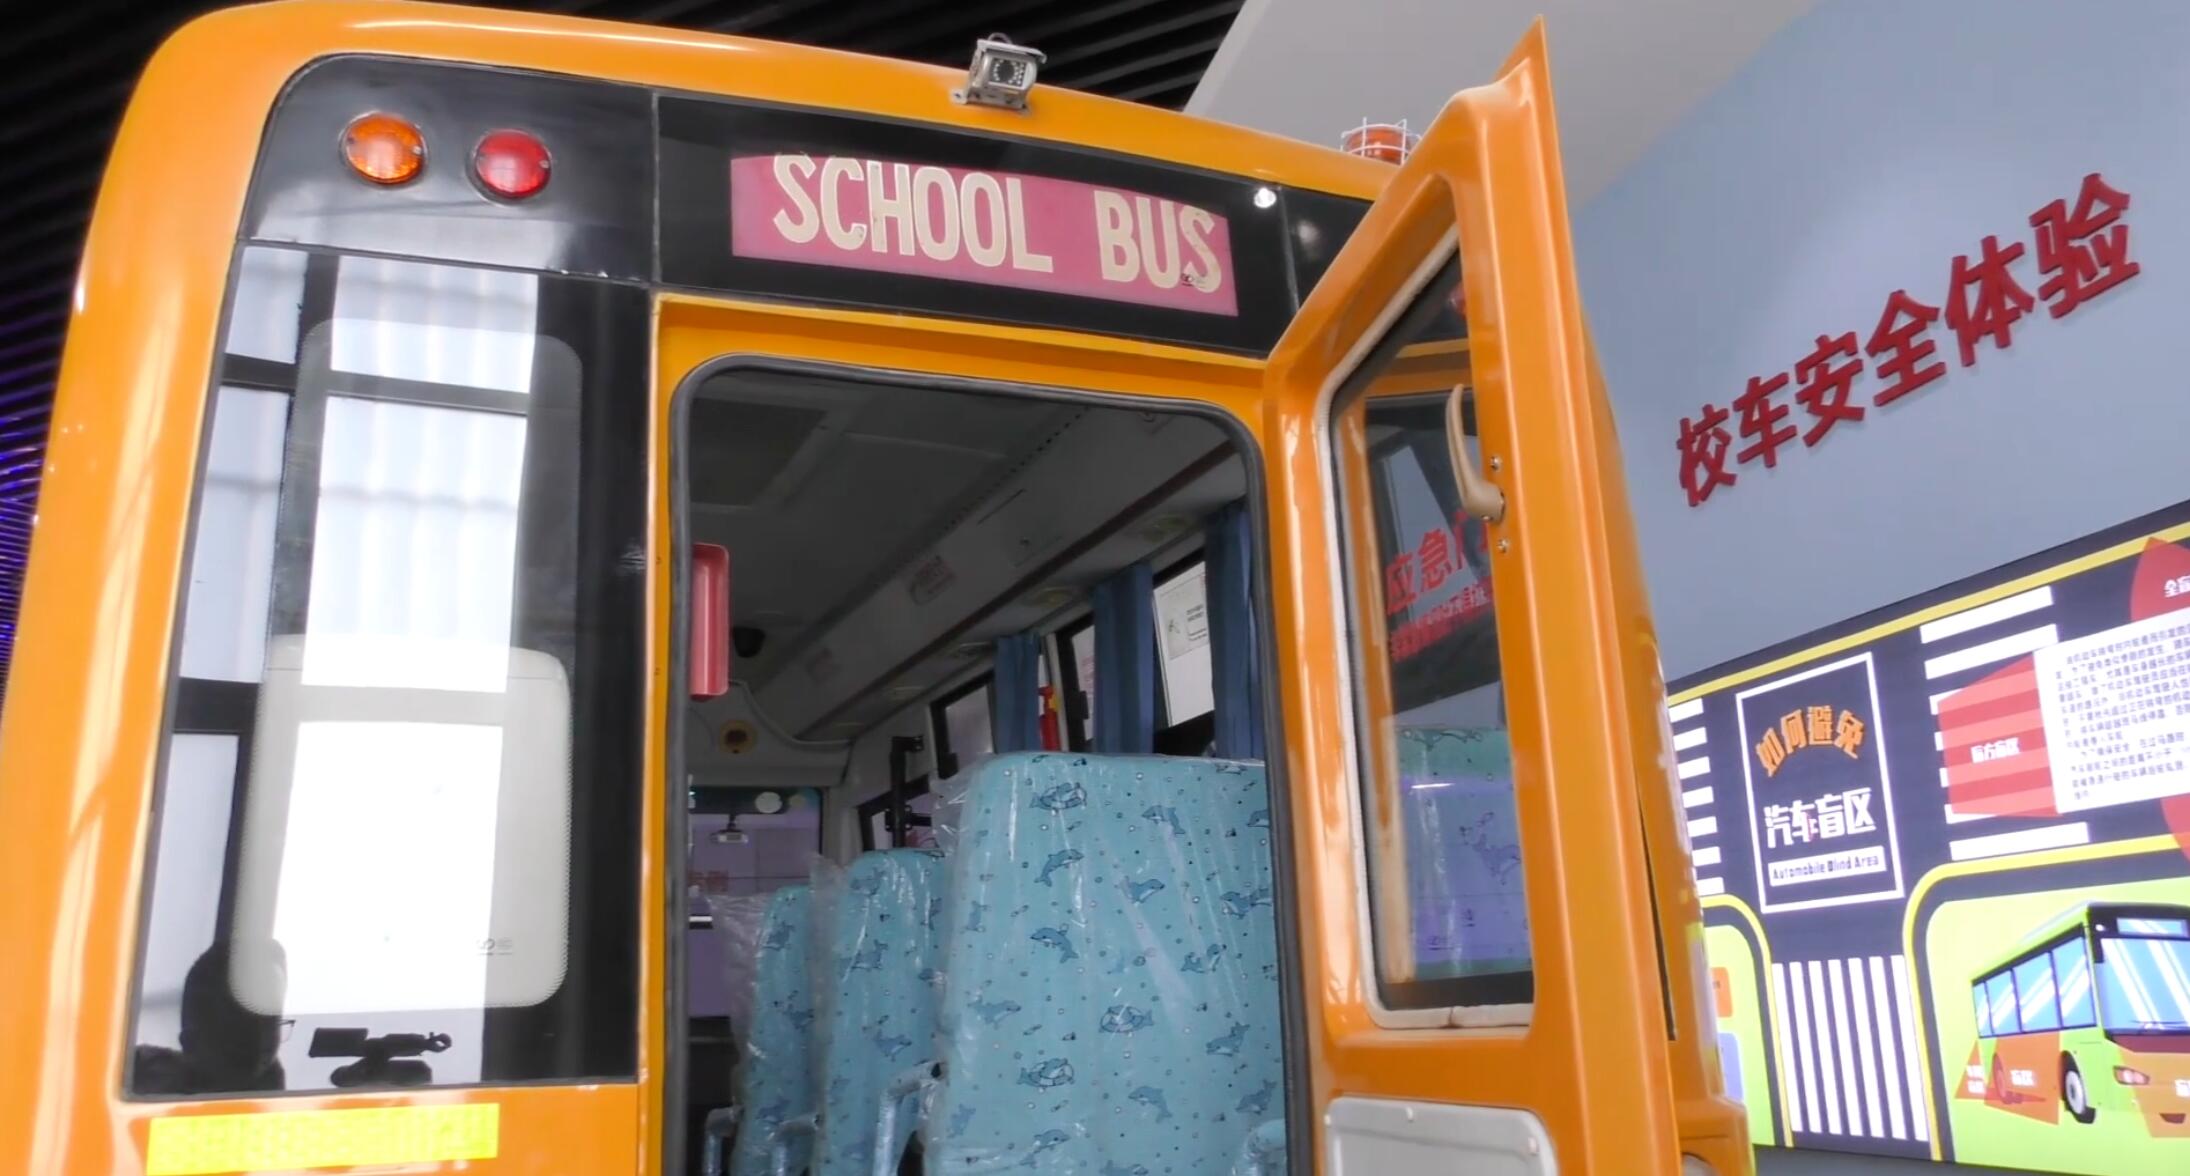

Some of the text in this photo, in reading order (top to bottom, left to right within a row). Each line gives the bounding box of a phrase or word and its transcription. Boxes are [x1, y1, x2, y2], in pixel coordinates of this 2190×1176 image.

[773, 153, 1222, 293] SCHOOL BUS
[1676, 172, 2141, 508] 校车安全体验
[1763, 787, 1877, 849] 汽车盲区
[1773, 861, 1825, 879] Automobile
[1854, 855, 1879, 868] Area
